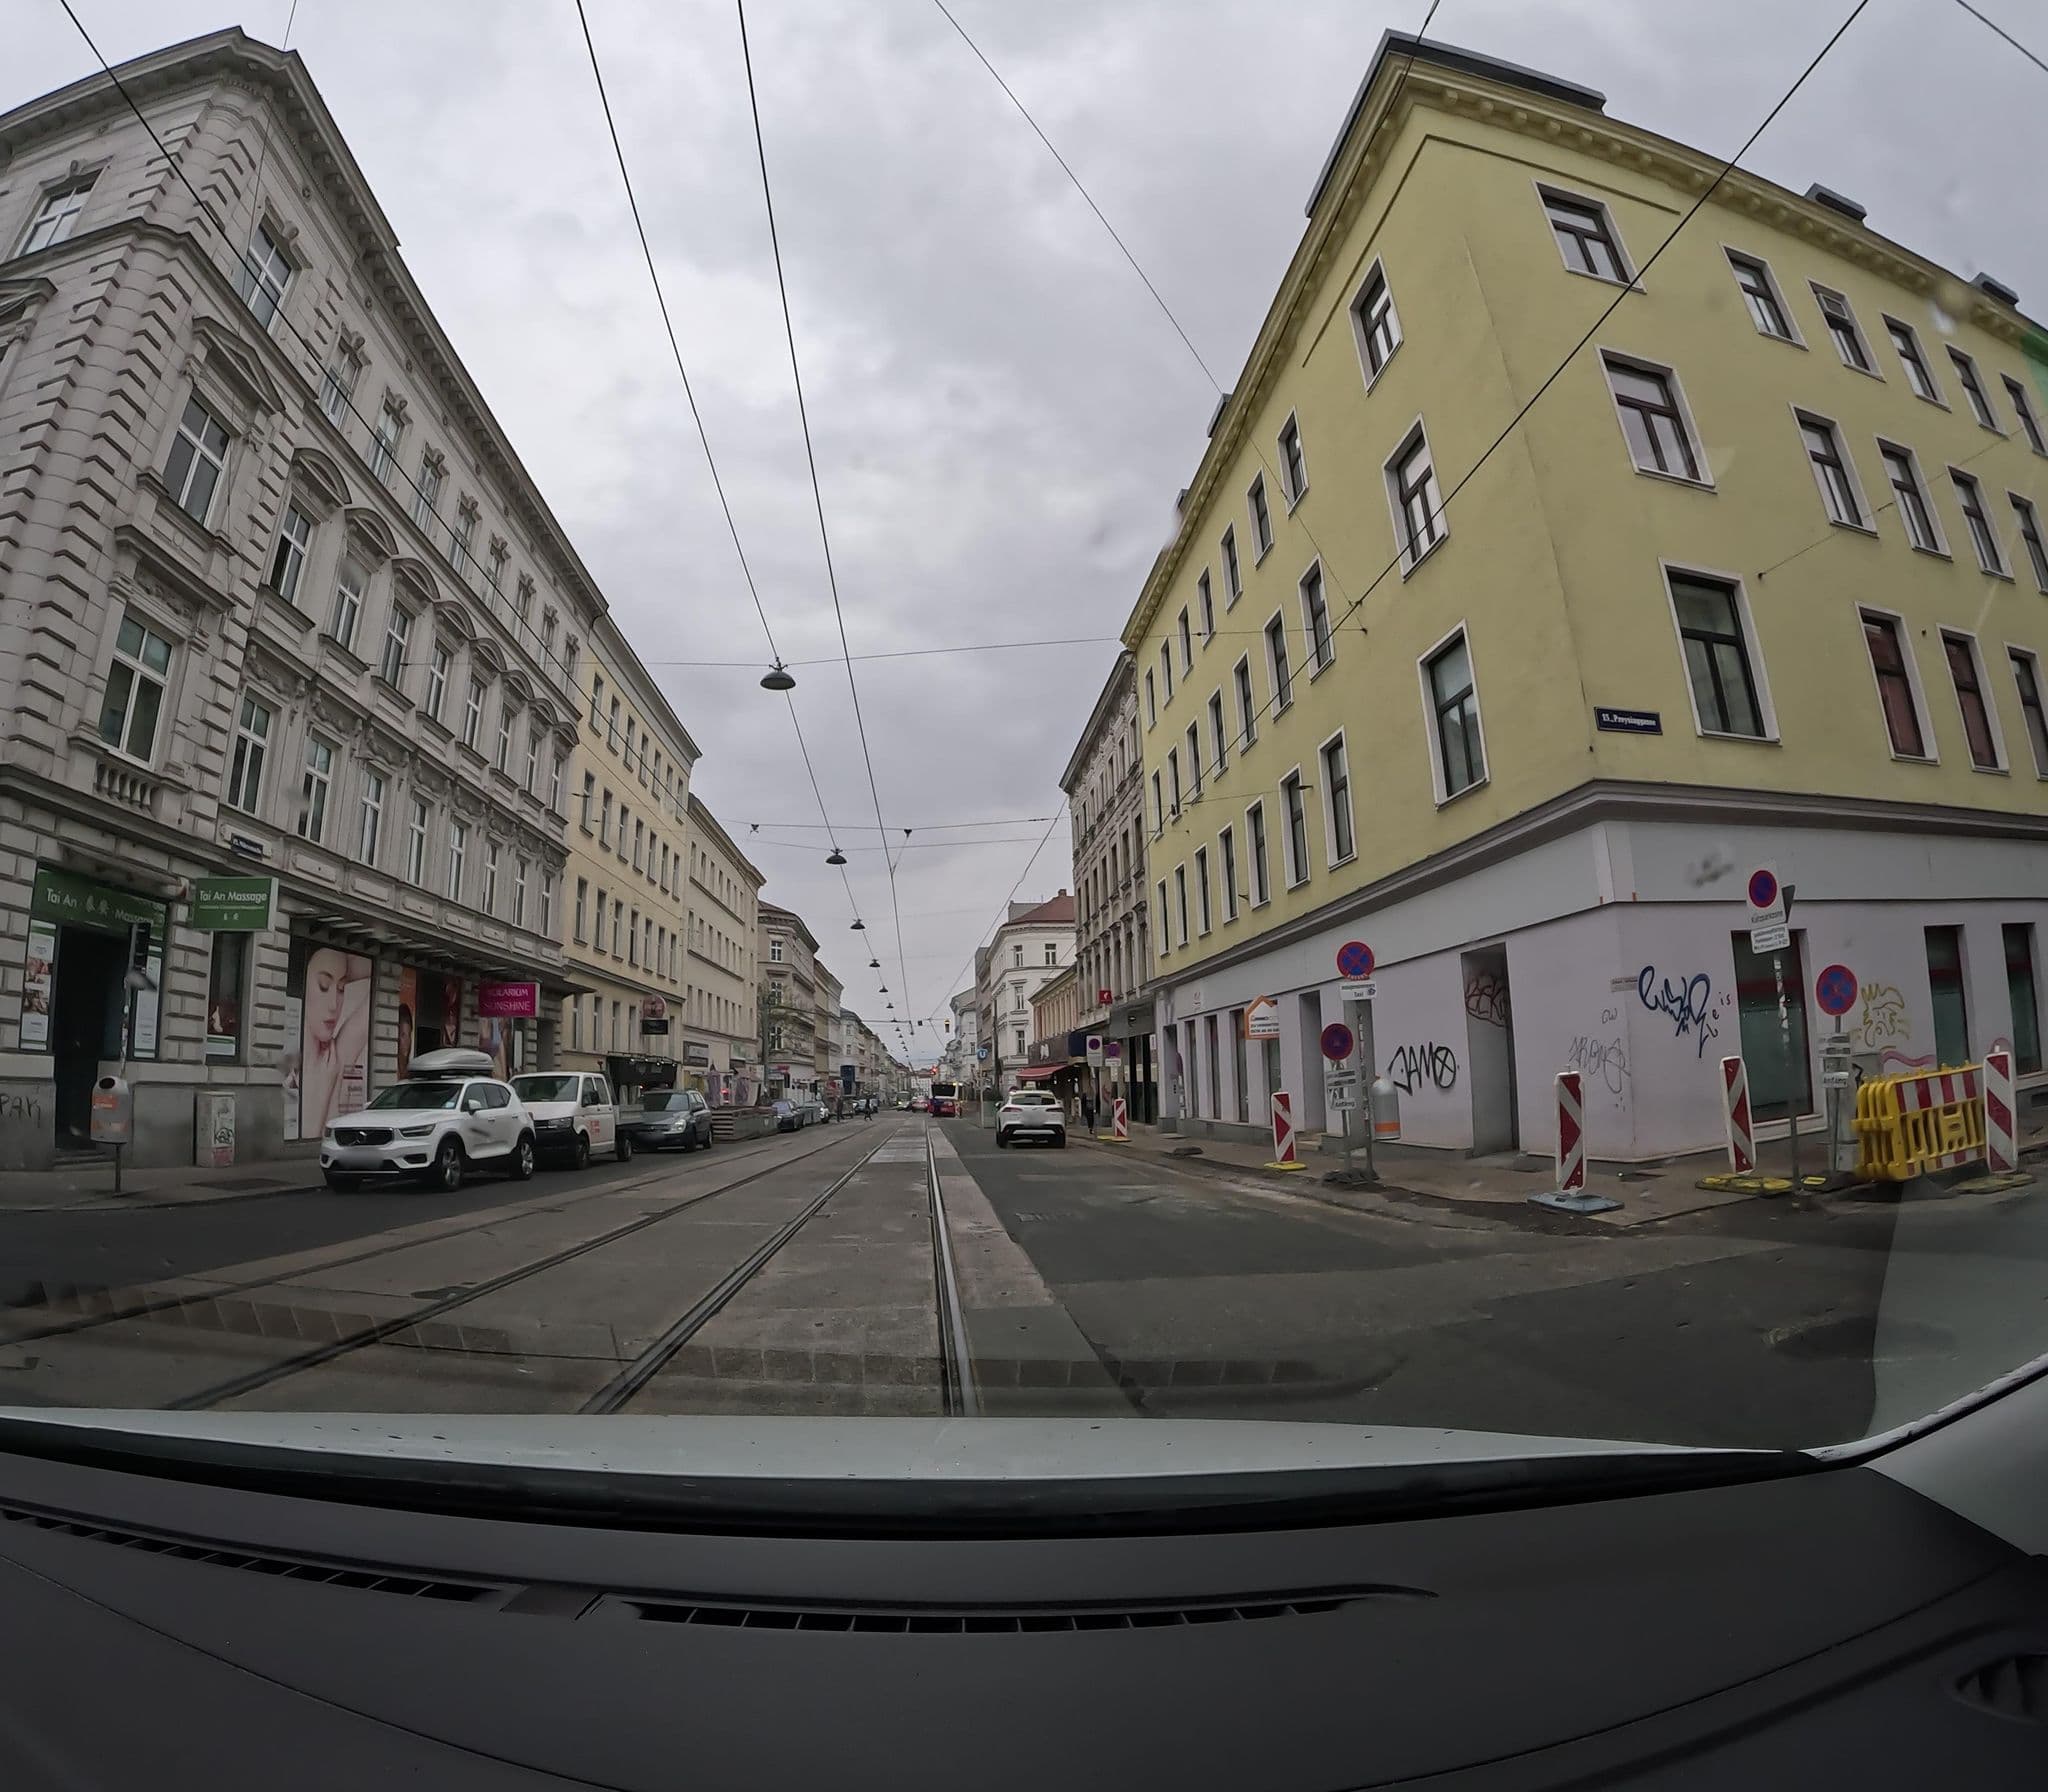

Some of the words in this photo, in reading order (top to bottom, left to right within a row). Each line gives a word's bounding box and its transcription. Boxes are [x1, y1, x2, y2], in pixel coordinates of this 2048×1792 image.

[46, 887, 60, 904] Tai
[63, 894, 77, 907] An
[200, 890, 211, 901] Tai
[213, 891, 226, 901] An
[227, 891, 267, 904] Massage
